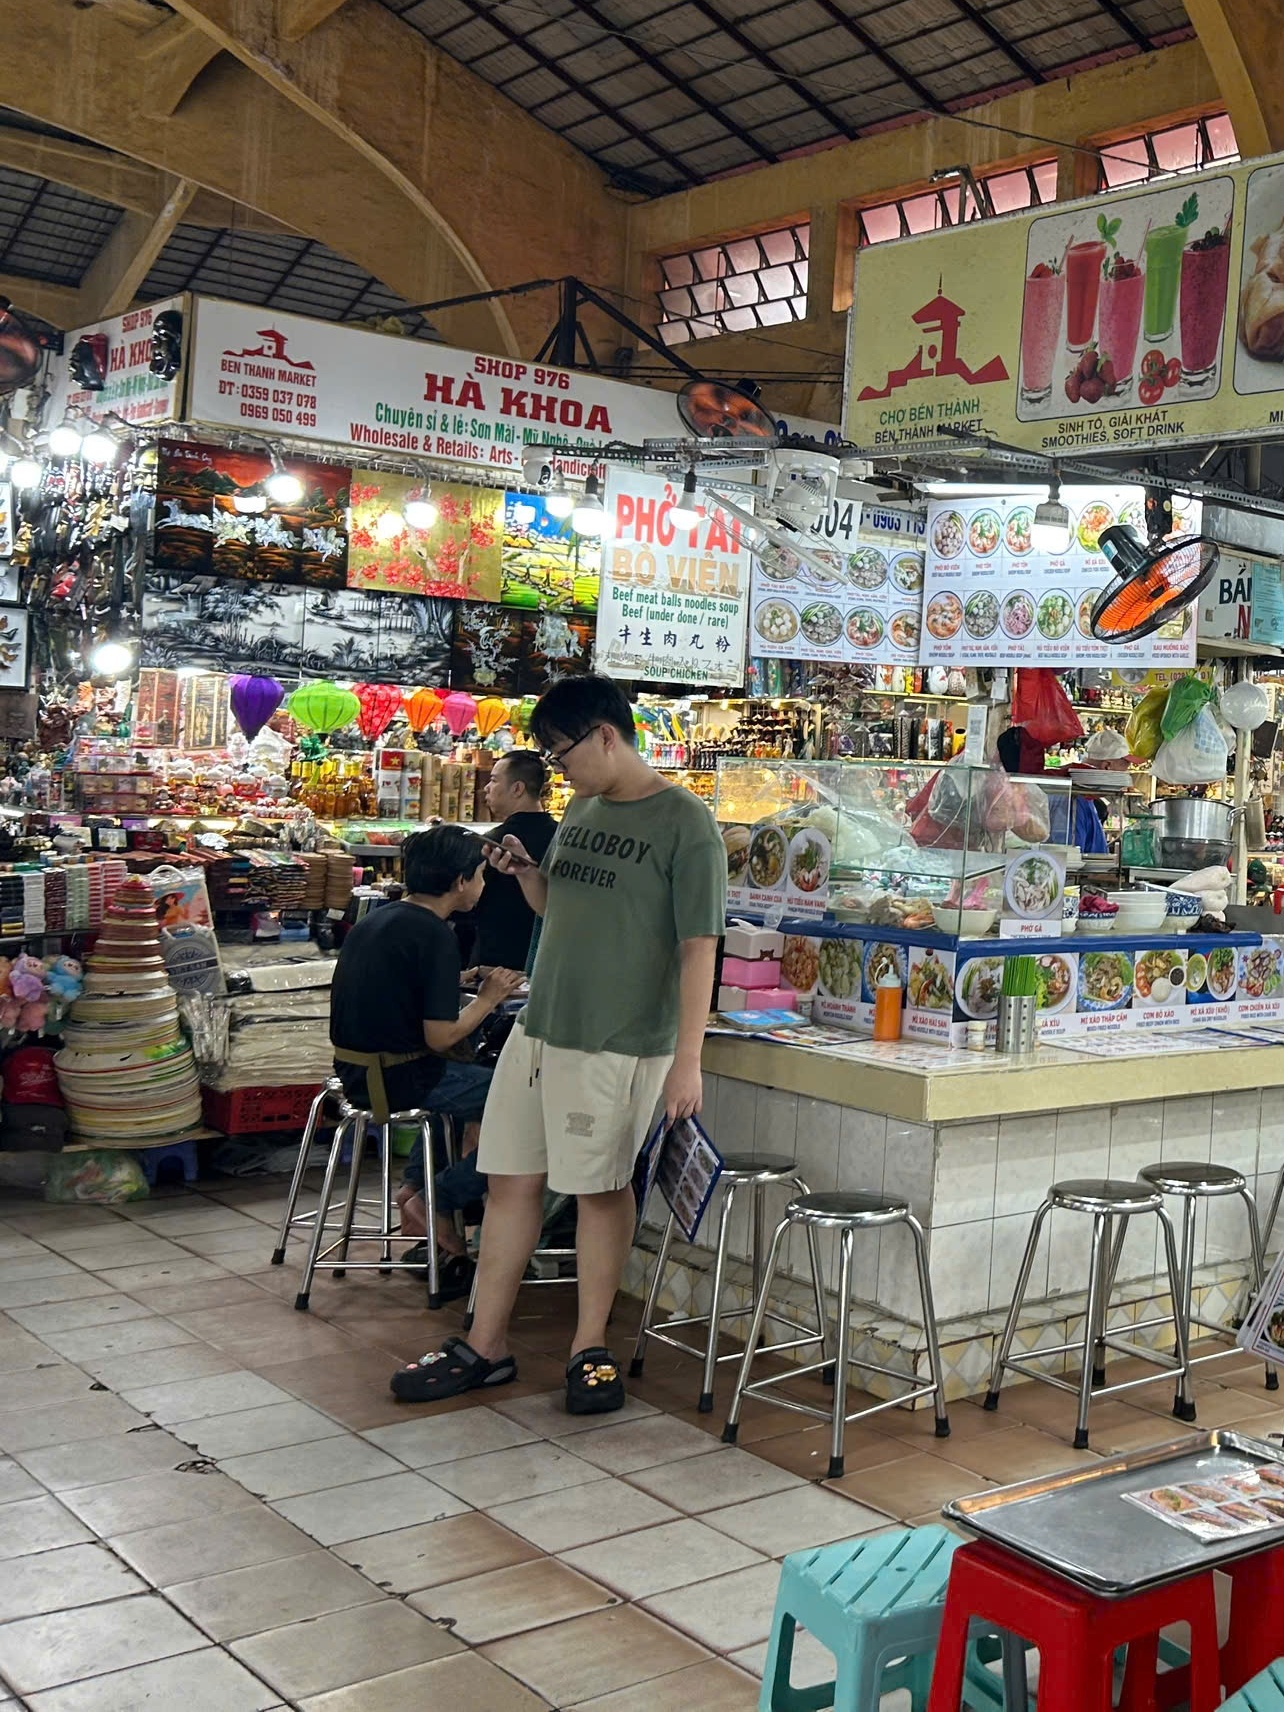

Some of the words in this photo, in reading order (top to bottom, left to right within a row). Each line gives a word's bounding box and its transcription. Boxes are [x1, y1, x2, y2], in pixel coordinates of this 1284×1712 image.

[221, 359, 240, 374] BEN
[244, 363, 275, 379] THANH
[278, 369, 316, 387] MARKET
[474, 356, 527, 381] SHOP
[534, 367, 570, 390] 976
[241, 383, 269, 401] 0359
[272, 389, 293, 405] 037
[296, 393, 316, 409] 078
[423, 372, 486, 411] HÀ
[499, 387, 612, 434] KHOA
[880, 409, 907, 426] CHỢ
[937, 396, 980, 417] THÀNH
[240, 403, 268, 420] 0969
[272, 408, 292, 424] 050
[296, 411, 316, 427] 499
[375, 402, 423, 429] Chuyên
[440, 417, 449, 432] &
[1058, 420, 1084, 433] SINH
[1109, 412, 1132, 427] GIẢI
[1135, 408, 1168, 424] KHÁT
[350, 423, 418, 451] Wholesale
[423, 435, 432, 452] &
[436, 437, 484, 460] Retails:
[1113, 426, 1144, 441] SOFT
[1147, 421, 1184, 436] DRINK
[615, 483, 678, 547] PHỞ
[611, 544, 657, 586] BÒ
[667, 552, 740, 597] VIÊN
[612, 587, 634, 602] Beef
[636, 591, 658, 605] meat
[661, 593, 682, 608] balls
[684, 596, 717, 612] noodles
[719, 601, 739, 616] soup
[622, 604, 643, 619] Beef
[646, 607, 674, 622] (under
[677, 610, 698, 625] done
[707, 614, 729, 629] rare)
[644, 665, 667, 678] SOUP
[670, 666, 709, 681] CHICKEN
[557, 826, 650, 865] HELLOBOY
[550, 859, 616, 889] FOREVER
